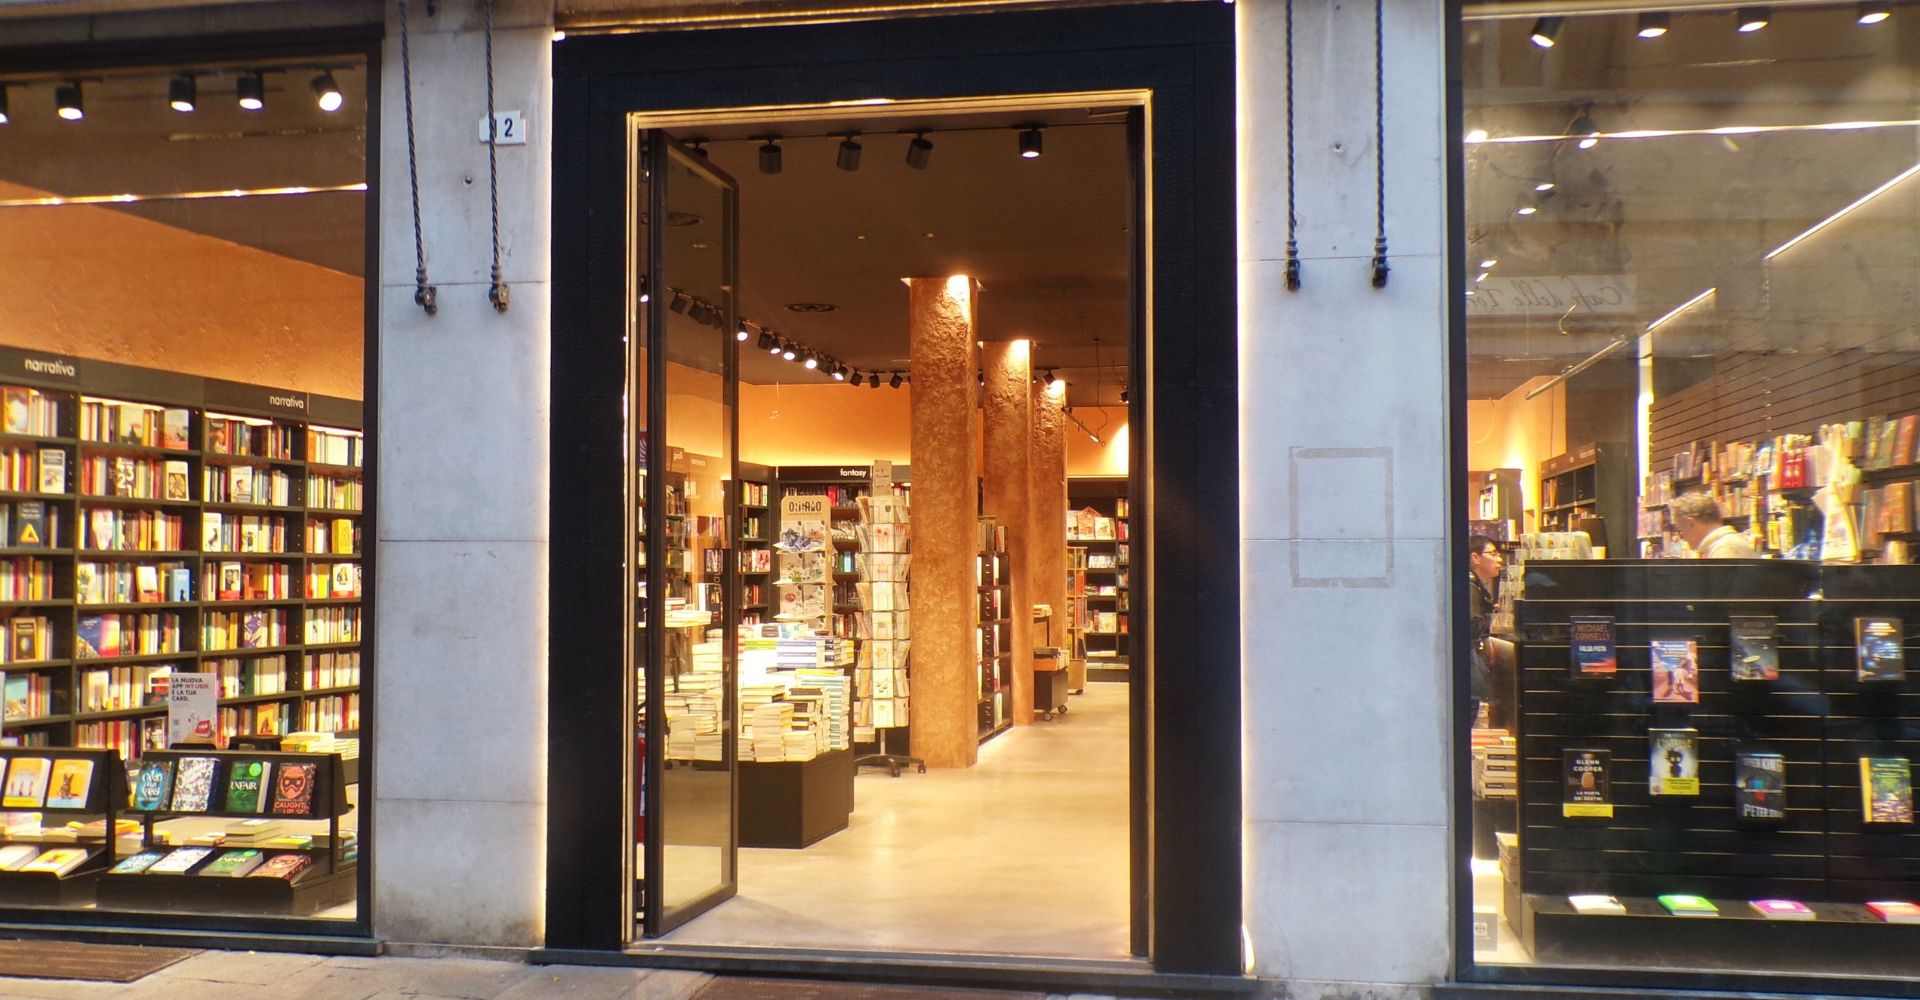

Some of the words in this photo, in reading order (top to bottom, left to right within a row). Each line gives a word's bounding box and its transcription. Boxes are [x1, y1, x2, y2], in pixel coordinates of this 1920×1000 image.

[24, 358, 75, 377] narrativa
[269, 395, 304, 409] narrativa
[840, 468, 867, 478] fantasy
